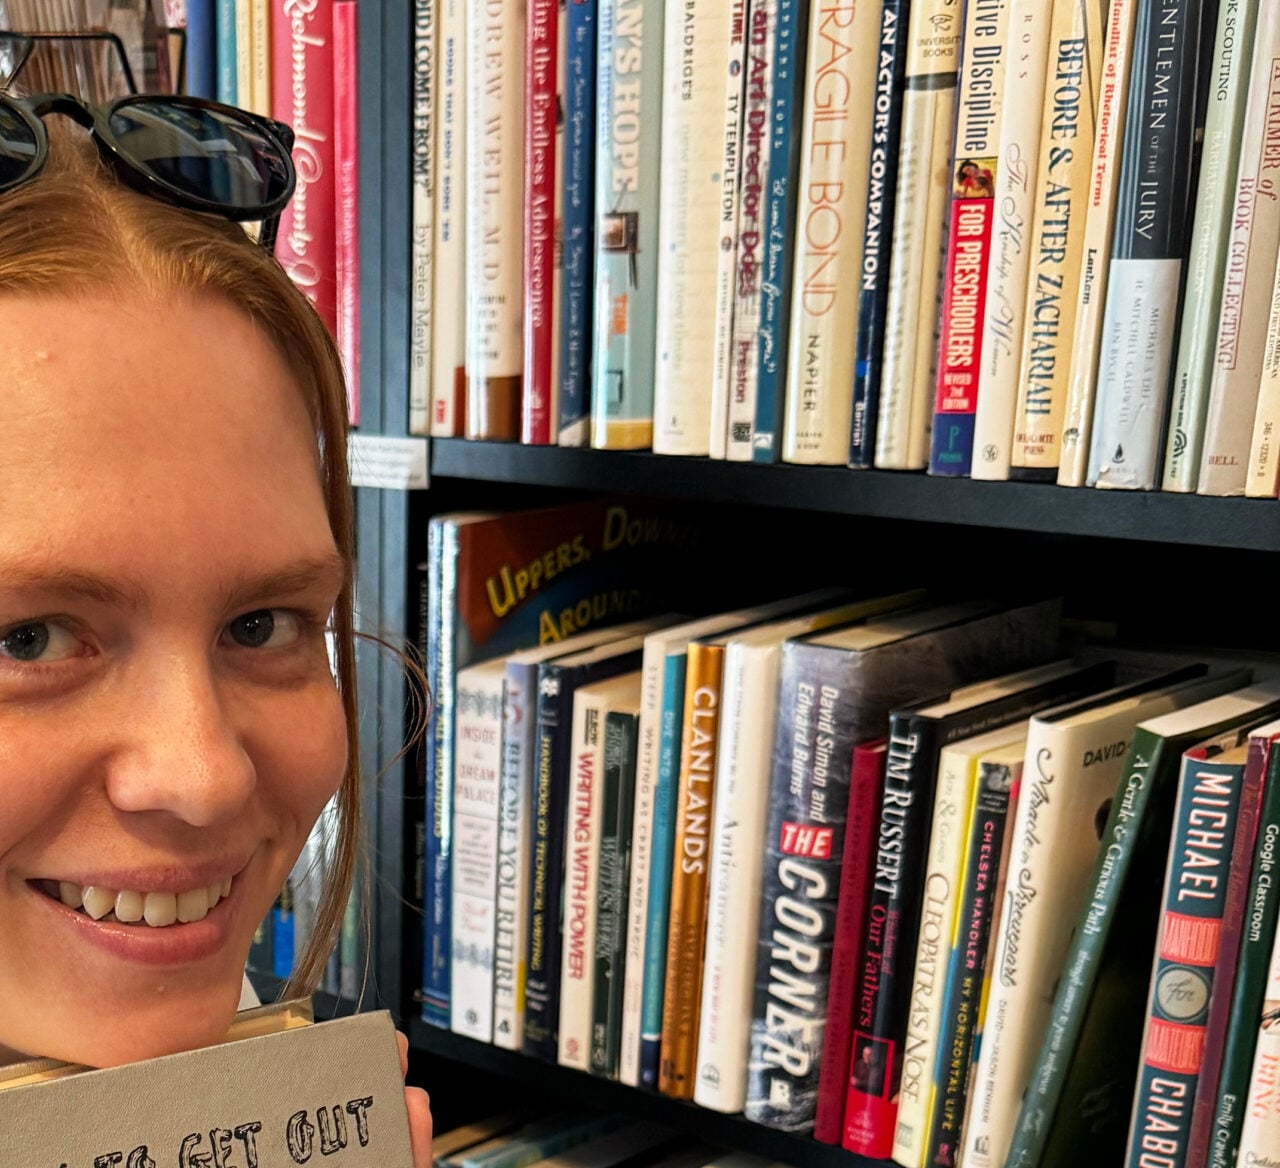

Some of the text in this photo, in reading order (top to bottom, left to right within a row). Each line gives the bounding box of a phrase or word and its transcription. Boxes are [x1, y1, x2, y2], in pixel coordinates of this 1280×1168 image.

[415, 40, 431, 110] COME
[917, 35, 960, 48] UNIVERSIT
[964, 45, 1004, 153] Discipline
[1215, 18, 1237, 102] SCOUTING
[529, 47, 552, 329] the Endless Adolescence
[612, 81, 641, 194] HOPE
[722, 121, 737, 222] TEMPLETON
[739, 10, 769, 300] an Art Director Does
[862, 8, 898, 291] AN ACTOR'S COMPANION
[1092, 84, 1115, 208] Rhetorical Terms
[988, 143, 1029, 379] The Kinship Women
[1025, 37, 1088, 416] BEFORE & AFTER ZACHARIAH
[1135, 181, 1160, 241] JURY
[802, 181, 845, 413] BOND NAPIER
[946, 203, 986, 368] FOR PRESCHOOLERS
[1217, 178, 1256, 365] BOOK COLLECTING
[681, 686, 716, 876] CLANLANDS
[789, 681, 815, 796] Edward Burns
[809, 684, 839, 824] David Simon and
[1021, 747, 1054, 849] Miracle
[567, 752, 595, 981] WRITING WITH POWER
[781, 827, 831, 856] THE
[873, 733, 919, 901] TIM RUSSERT
[974, 820, 995, 892] CHELSEA
[1083, 773, 1147, 935] Gentle Curious Path
[1177, 771, 1234, 902] MICHAEL
[1259, 824, 1280, 872] Google
[762, 858, 827, 1077] CORNER
[859, 904, 888, 1028] Our Fathers
[964, 896, 985, 970] HANDLER
[1248, 874, 1272, 942] Classroom
[945, 1002, 970, 1095] HORIZONTAL
[286, 1096, 374, 1164] OUT
[1217, 1093, 1237, 1130] Emily
